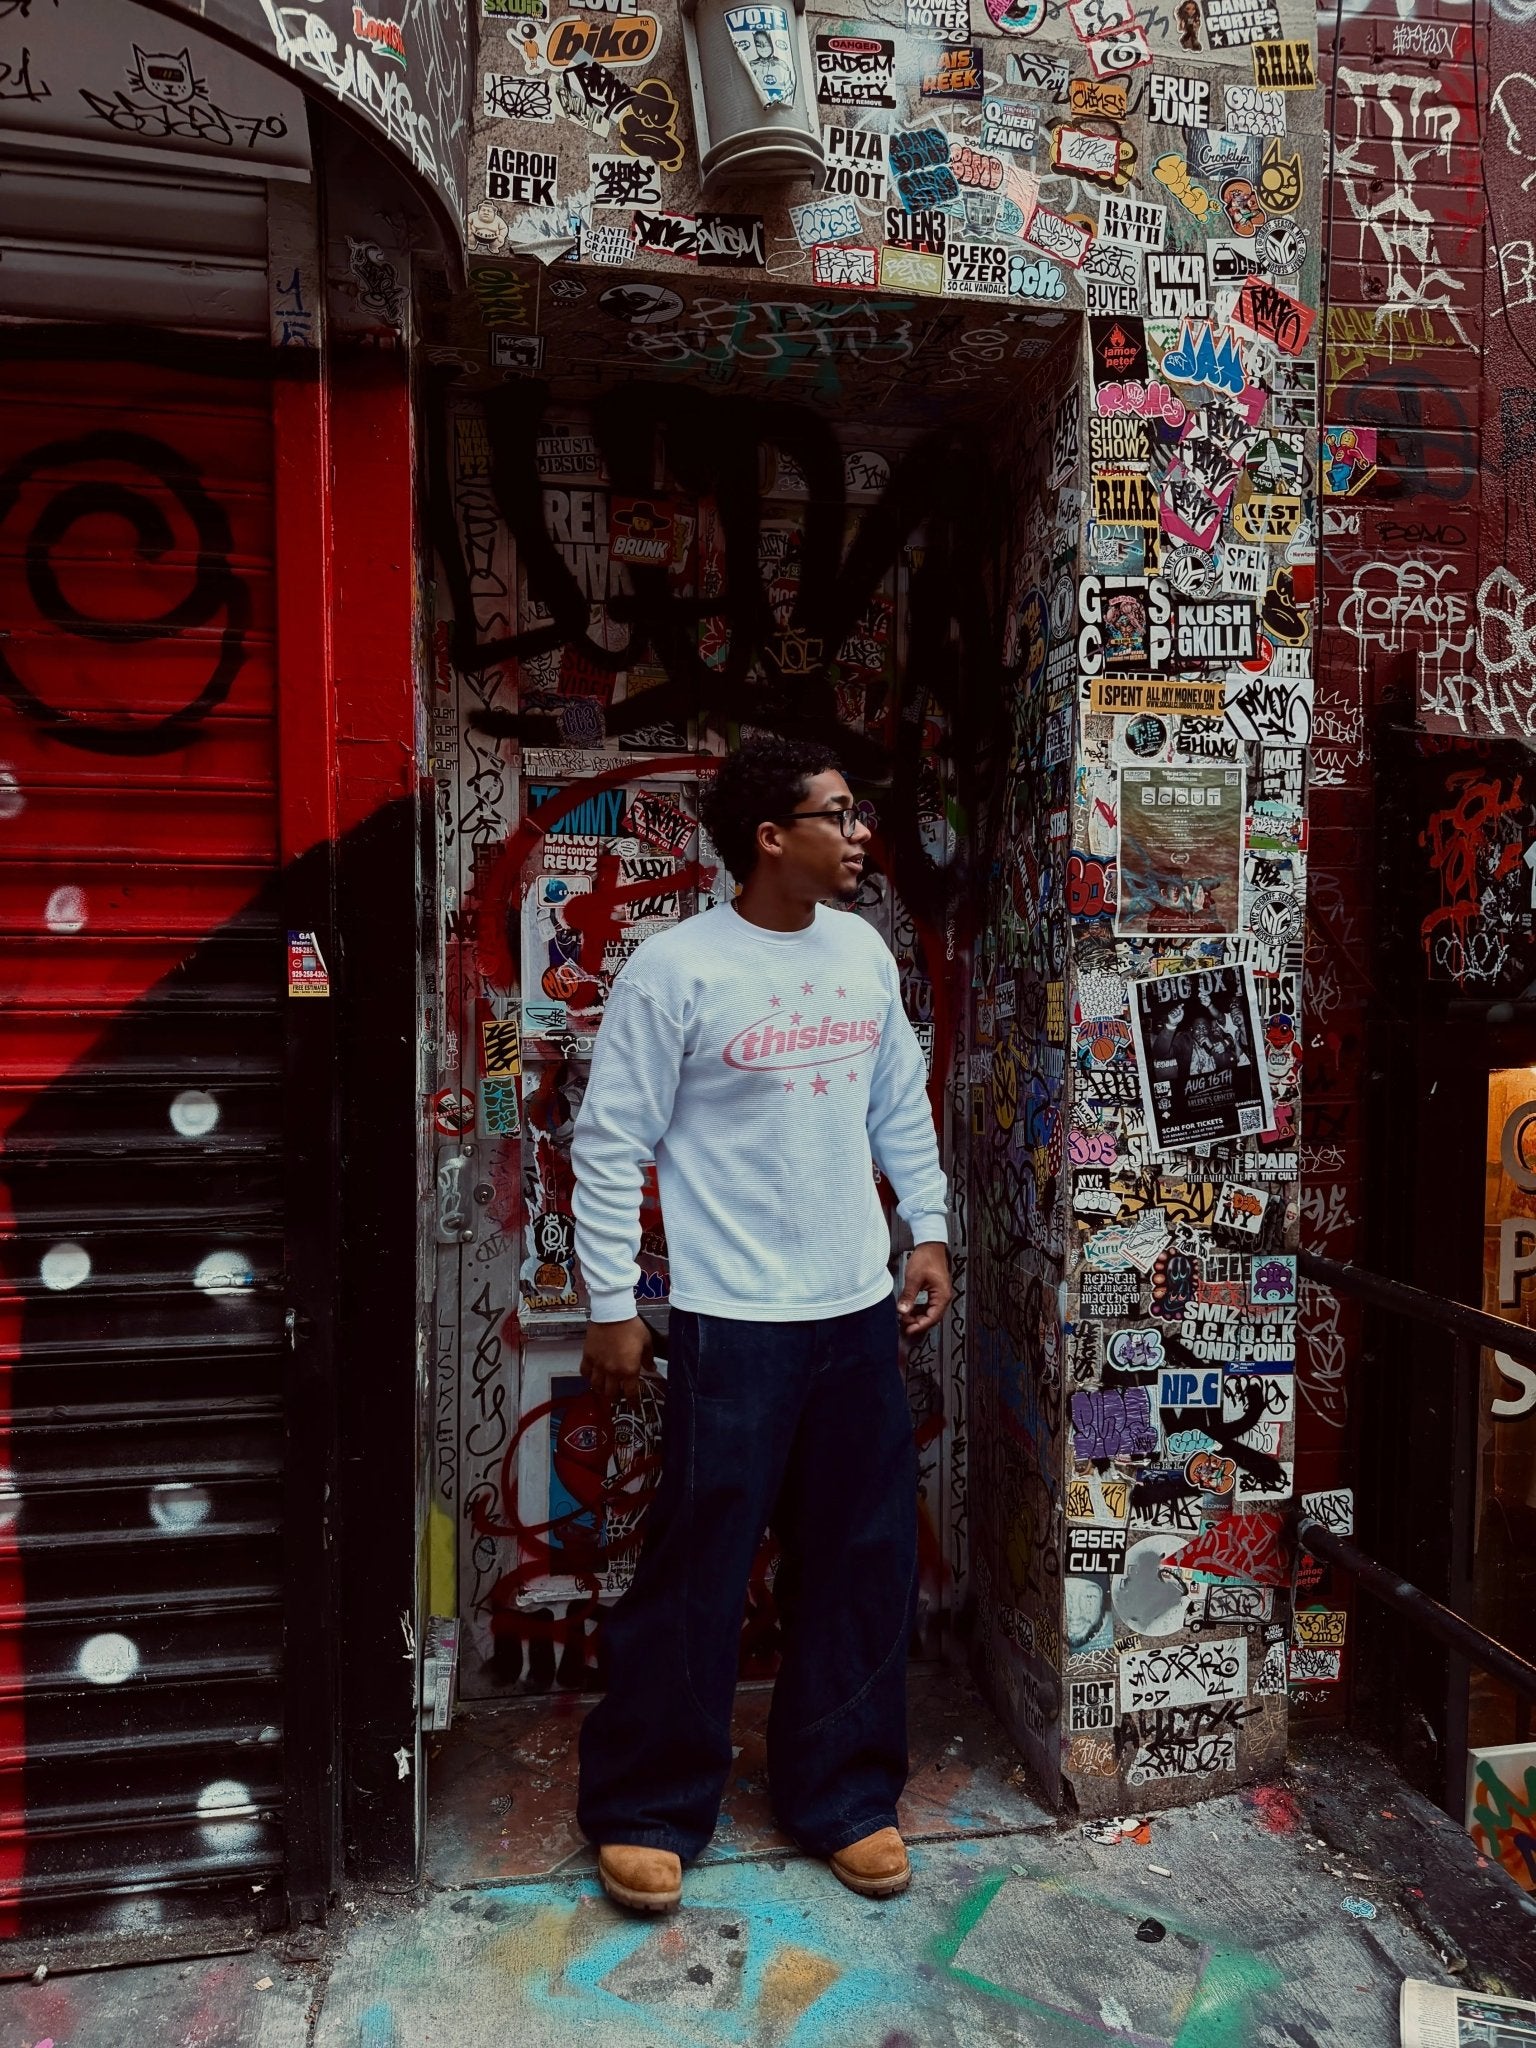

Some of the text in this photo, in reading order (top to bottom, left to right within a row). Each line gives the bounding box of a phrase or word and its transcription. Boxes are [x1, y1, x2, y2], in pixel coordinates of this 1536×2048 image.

[727, 8, 786, 28] VOTE
[907, 9, 969, 28] NOTER
[1207, 10, 1278, 31] CORTES
[553, 23, 649, 61] biko
[832, 40, 879, 50] DANGER
[1227, 27, 1266, 46] NYC
[1150, 75, 1209, 101] ERUP
[1150, 98, 1209, 128] JUNE
[829, 127, 883, 161] PIZA
[987, 127, 1034, 151] FANG
[488, 147, 557, 180] AGROH
[1200, 145, 1251, 168] Crooklyn
[488, 172, 555, 207] BEK
[824, 166, 885, 200] ZOOT
[1104, 199, 1162, 227] RARE
[600, 227, 627, 237] ANTI
[887, 207, 946, 241] STEN3
[1103, 218, 1161, 245] MYTH
[585, 239, 634, 259] GRAFFITI
[586, 231, 636, 250] GRAFFITI
[593, 254, 622, 264] CLUB
[948, 244, 1006, 265] PLEKO
[948, 262, 1006, 282] YZER
[1149, 256, 1204, 283] PIKZR
[948, 282, 1006, 295] SO CAL VANDALS
[1087, 284, 1138, 311] BUYER
[1106, 357, 1135, 367] peter
[538, 437, 594, 455] TRUST
[1092, 440, 1150, 459] SHOW2
[541, 456, 597, 473] JESUS
[1099, 526, 1142, 541] DMT
[1178, 605, 1249, 625] KUSH
[1178, 625, 1253, 657] GKILLA
[1269, 647, 1311, 678] MEEK
[1098, 685, 1103, 706] I
[1104, 685, 1143, 706] SPENT
[1146, 687, 1160, 700] ALL
[1161, 687, 1174, 701] MY
[1175, 688, 1202, 702] MONEY
[1204, 689, 1215, 703] ON
[1143, 793, 1219, 805] SCOUT
[545, 845, 598, 857] mind control
[544, 855, 598, 872] REWZ
[1157, 976, 1191, 1003] BIG
[742, 1016, 878, 1062] thisisus
[1184, 1069, 1233, 1096] AUG 16TH
[1161, 1117, 1224, 1135] SCAN FOR TICKETS
[1245, 1152, 1298, 1169] SPAIR
[1078, 1174, 1103, 1189] NYC
[1262, 1173, 1298, 1181] TNT CULT
[1220, 1202, 1253, 1229] NY
[1082, 1292, 1140, 1304] MATTHEW
[1083, 1284, 1102, 1293] REST
[1111, 1284, 1138, 1293] PEACE
[1184, 1301, 1239, 1325] SMIZ
[1181, 1322, 1239, 1343] Q.C.K
[1240, 1323, 1296, 1343] Q.C.K
[1240, 1343, 1296, 1362] POND
[1069, 1529, 1126, 1549] 125ER
[1069, 1553, 1120, 1573] CULT
[1072, 1682, 1114, 1706] HOT
[1072, 1705, 1114, 1729] ROD
